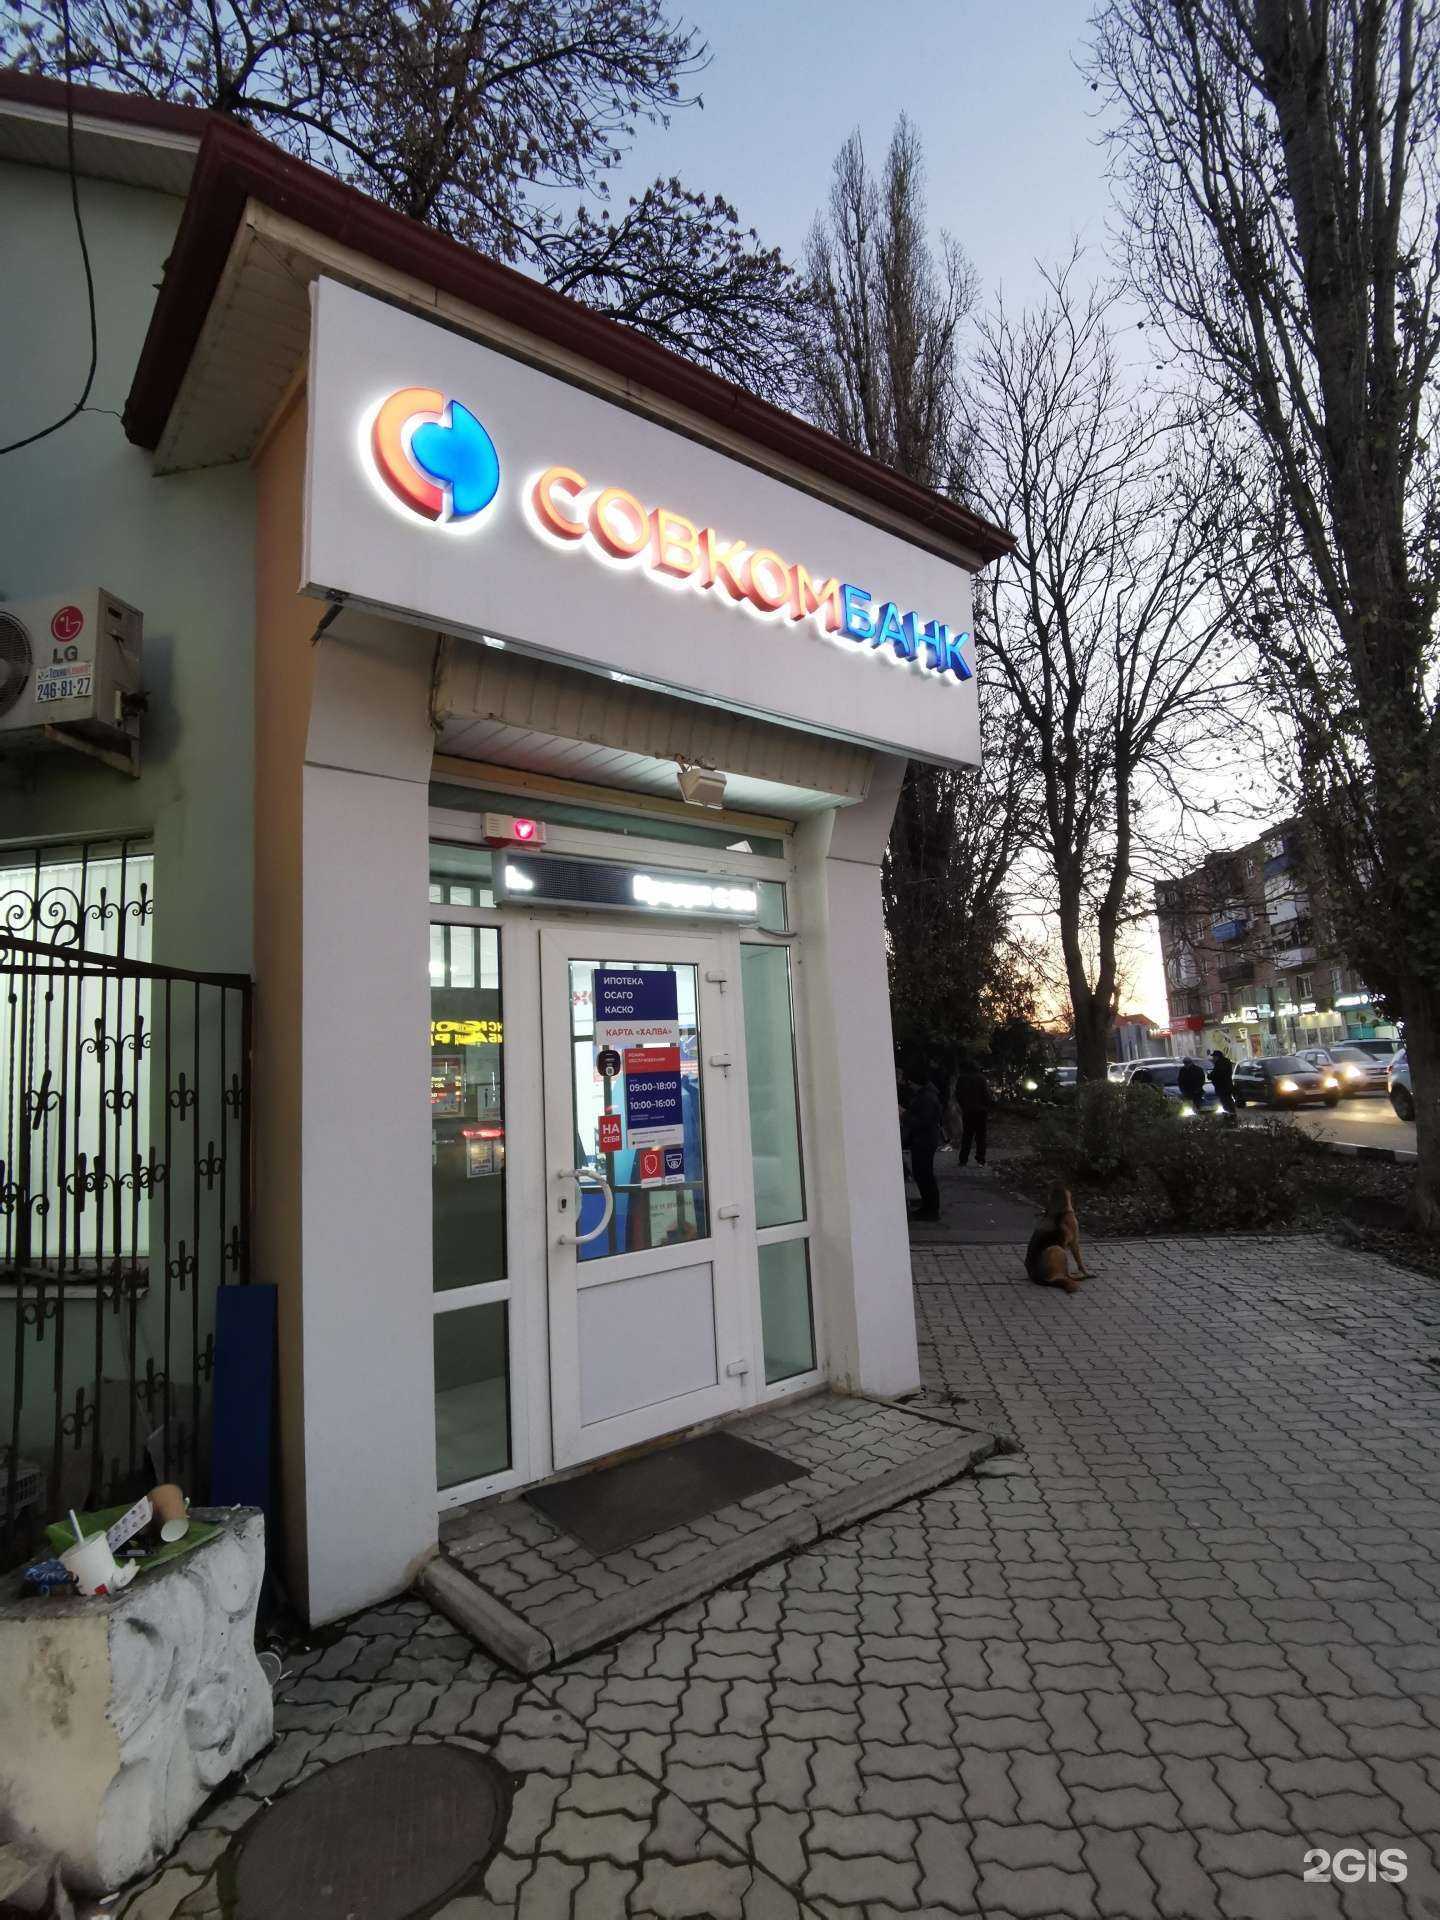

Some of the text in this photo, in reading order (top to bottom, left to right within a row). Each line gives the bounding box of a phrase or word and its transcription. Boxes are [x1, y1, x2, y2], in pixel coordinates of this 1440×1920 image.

[530, 465, 973, 682] СОВКОМБАНК
[53, 645, 79, 664] LG
[603, 976, 644, 985] ИПОТЕКА
[604, 991, 634, 999] ОСАГО
[604, 1006, 634, 1014] КАСКО
[606, 1028, 634, 1037] КАРТА
[602, 1123, 620, 1135] НА
[602, 1135, 620, 1143] СЕБЯ
